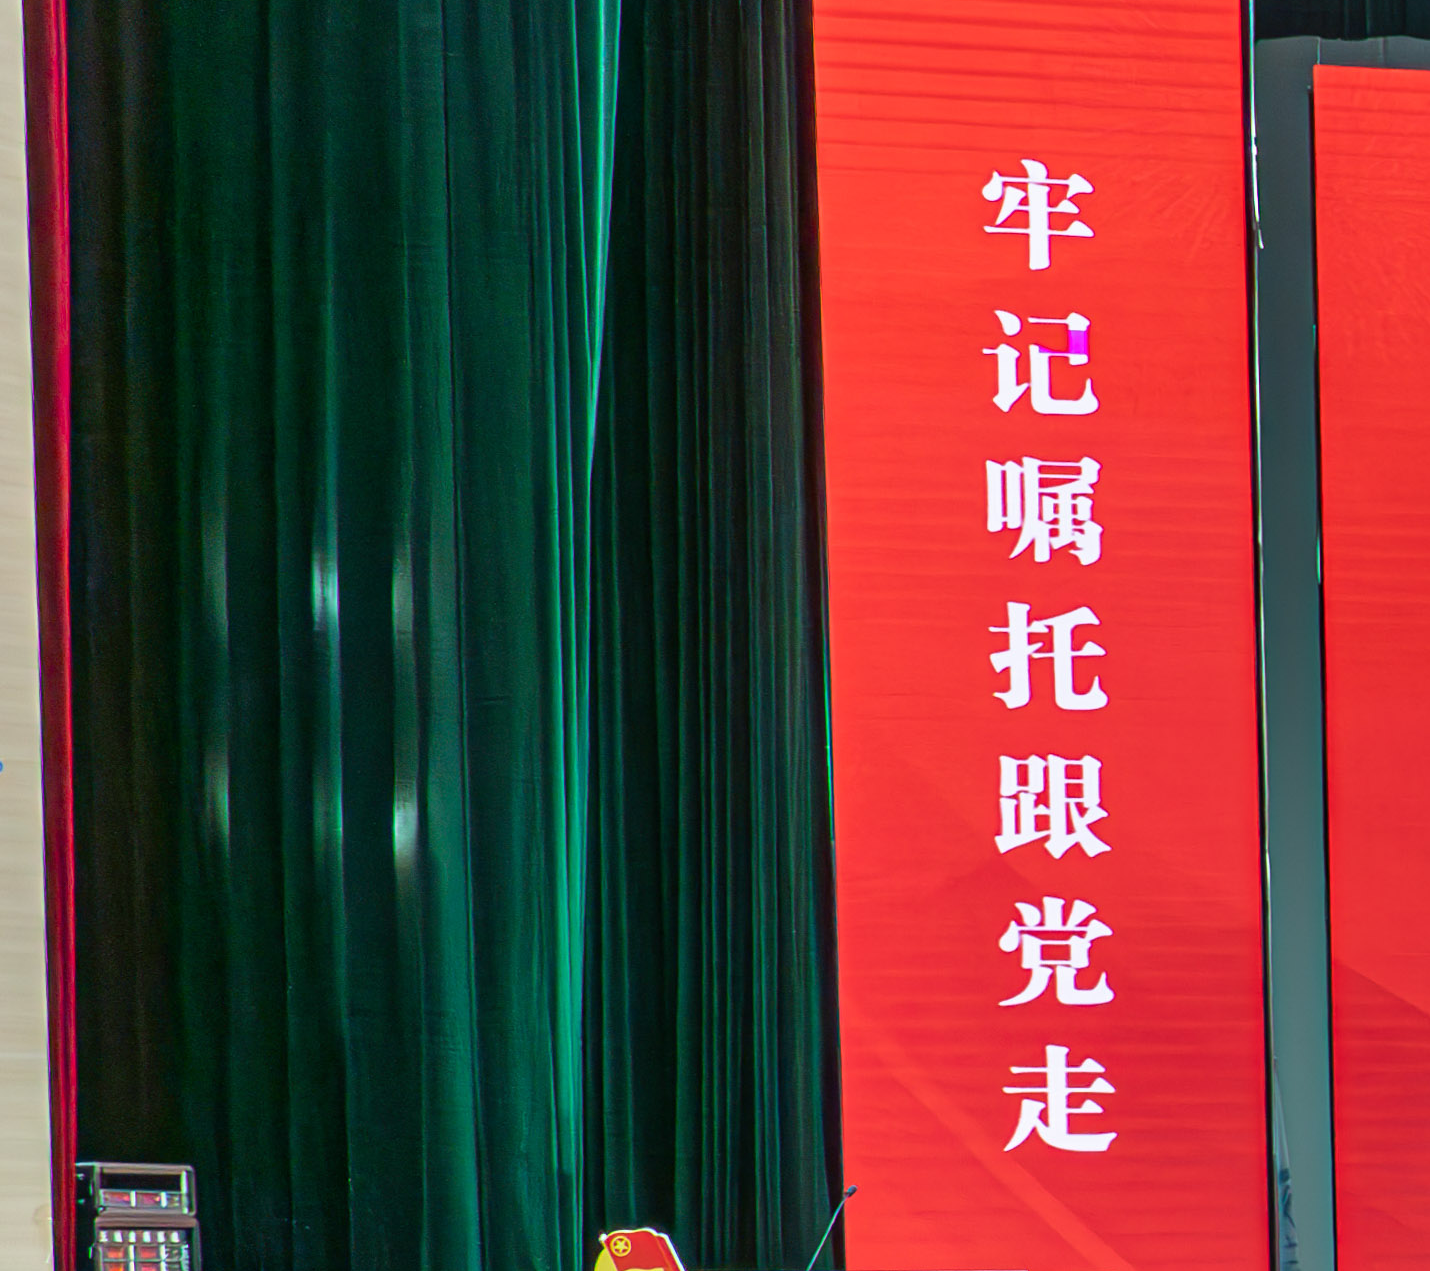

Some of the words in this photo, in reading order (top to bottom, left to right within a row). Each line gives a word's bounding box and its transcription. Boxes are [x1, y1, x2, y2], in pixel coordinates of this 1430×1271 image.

[981, 159, 1117, 1153] 牢记嘱托跟党走
